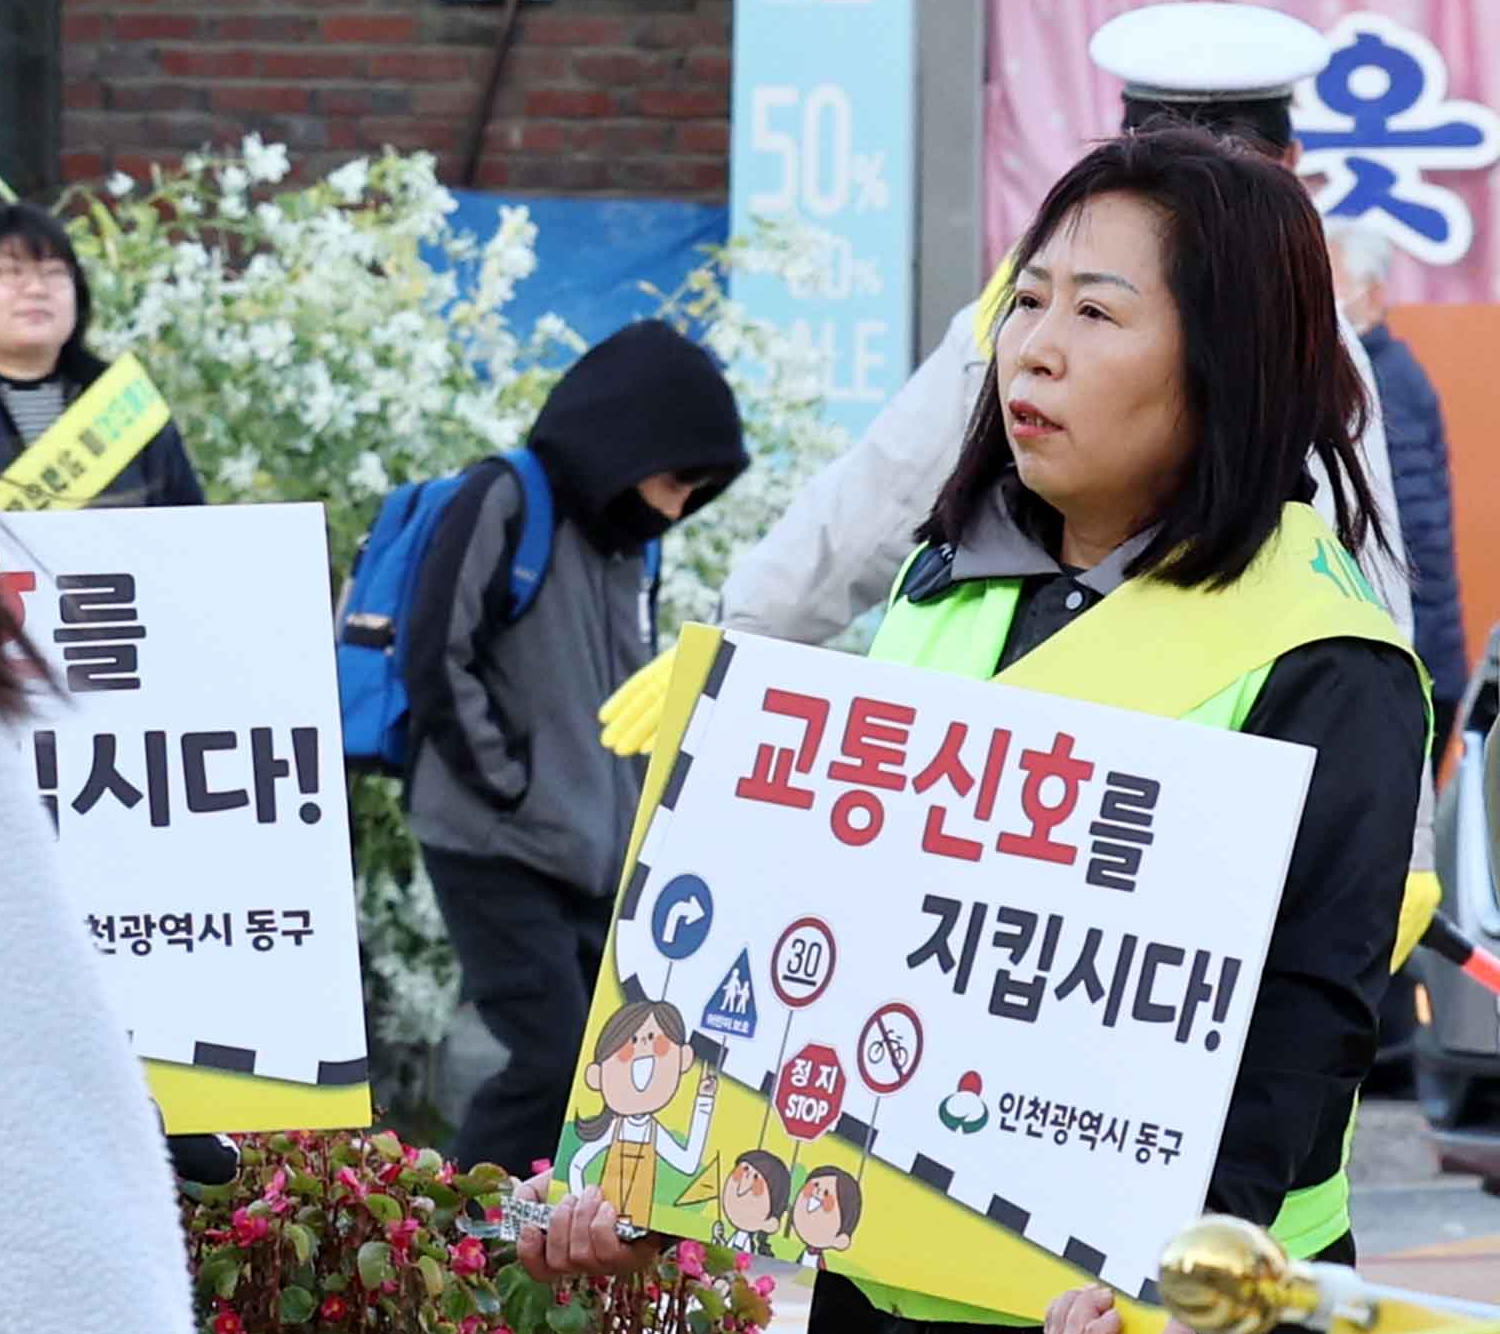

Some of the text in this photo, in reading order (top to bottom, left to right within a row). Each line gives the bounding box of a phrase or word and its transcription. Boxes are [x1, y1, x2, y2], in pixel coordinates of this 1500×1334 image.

[748, 84, 890, 218] 50%
[33, 726, 323, 842] 시다!
[735, 685, 1163, 894] 교통신호를
[246, 909, 315, 953] 동구
[786, 937, 823, 979] 30
[905, 892, 1243, 1054] 지킵시다!
[784, 1093, 829, 1125] STOP
[997, 1091, 1184, 1167] 인천광역시 동구
